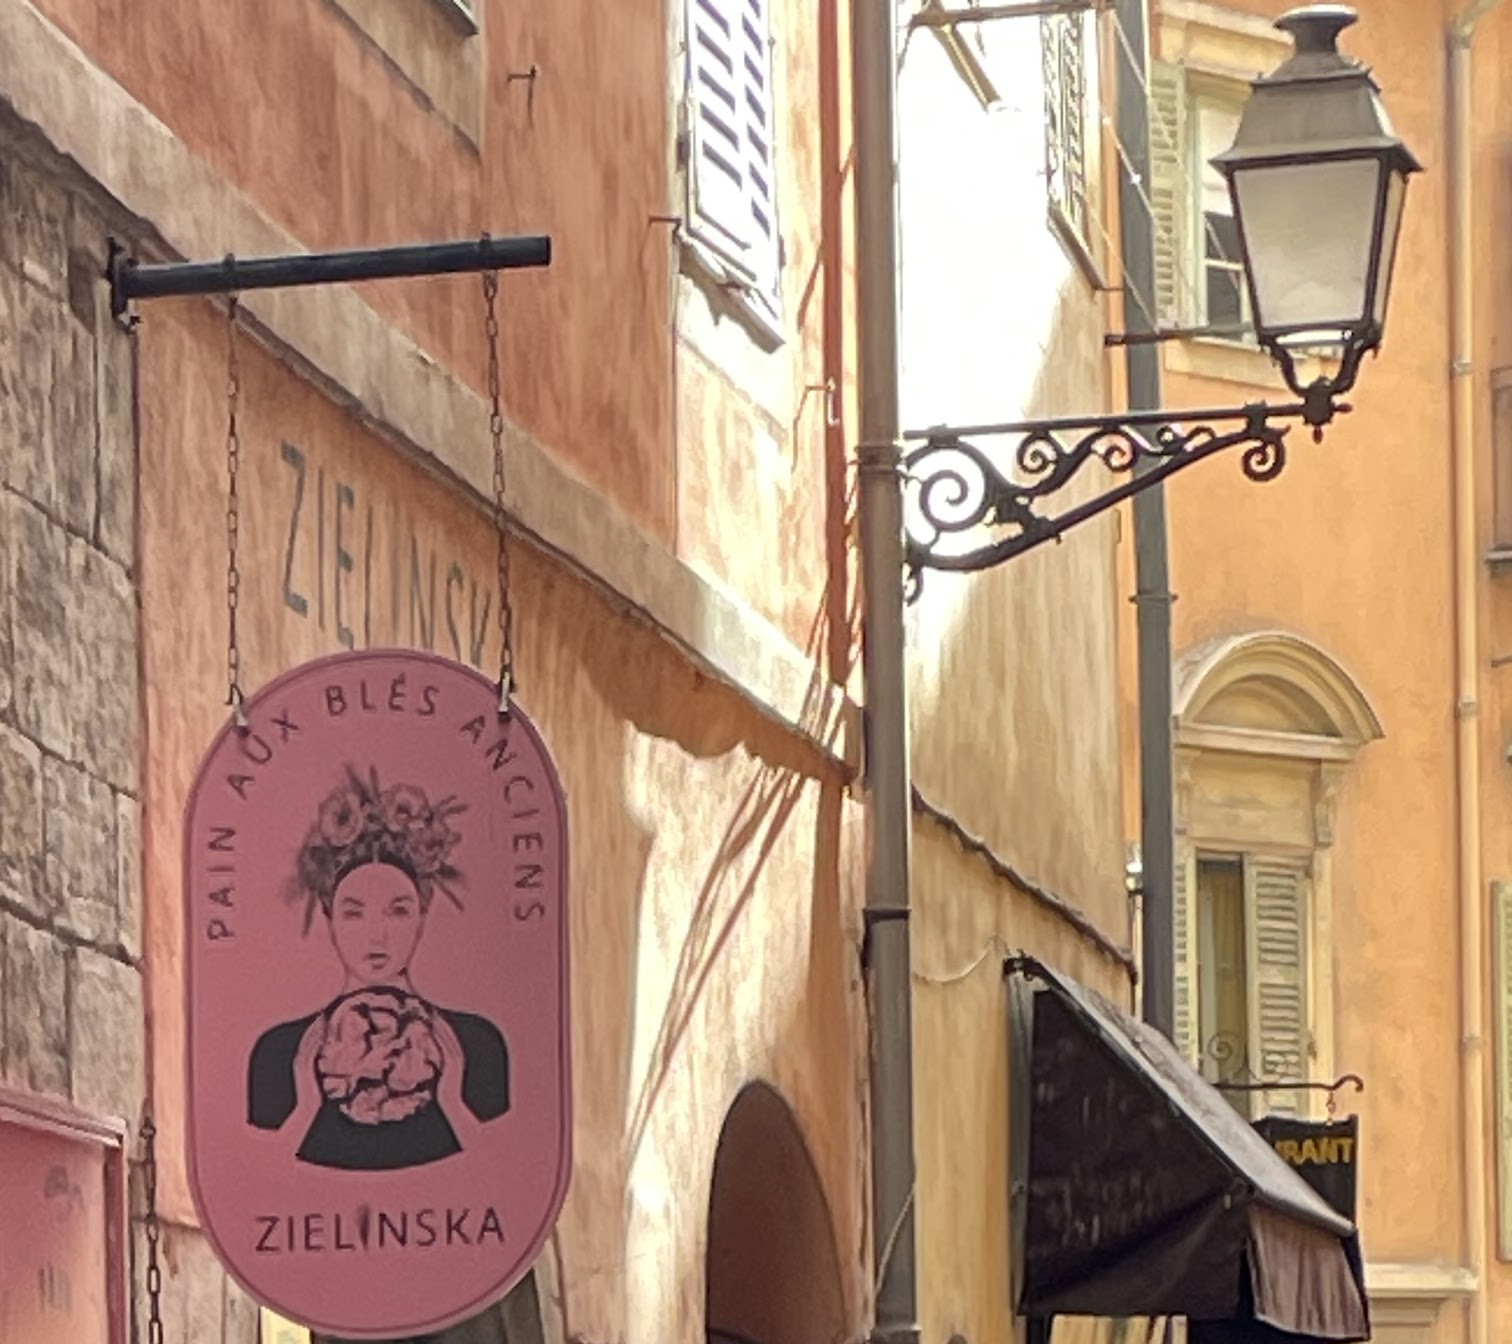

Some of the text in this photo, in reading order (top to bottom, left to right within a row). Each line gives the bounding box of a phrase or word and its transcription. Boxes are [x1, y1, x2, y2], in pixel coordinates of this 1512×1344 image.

[206, 672, 546, 942] PAIN AUX BLÉS ANCIENS
[254, 1202, 505, 1252] ZIELINSKA
